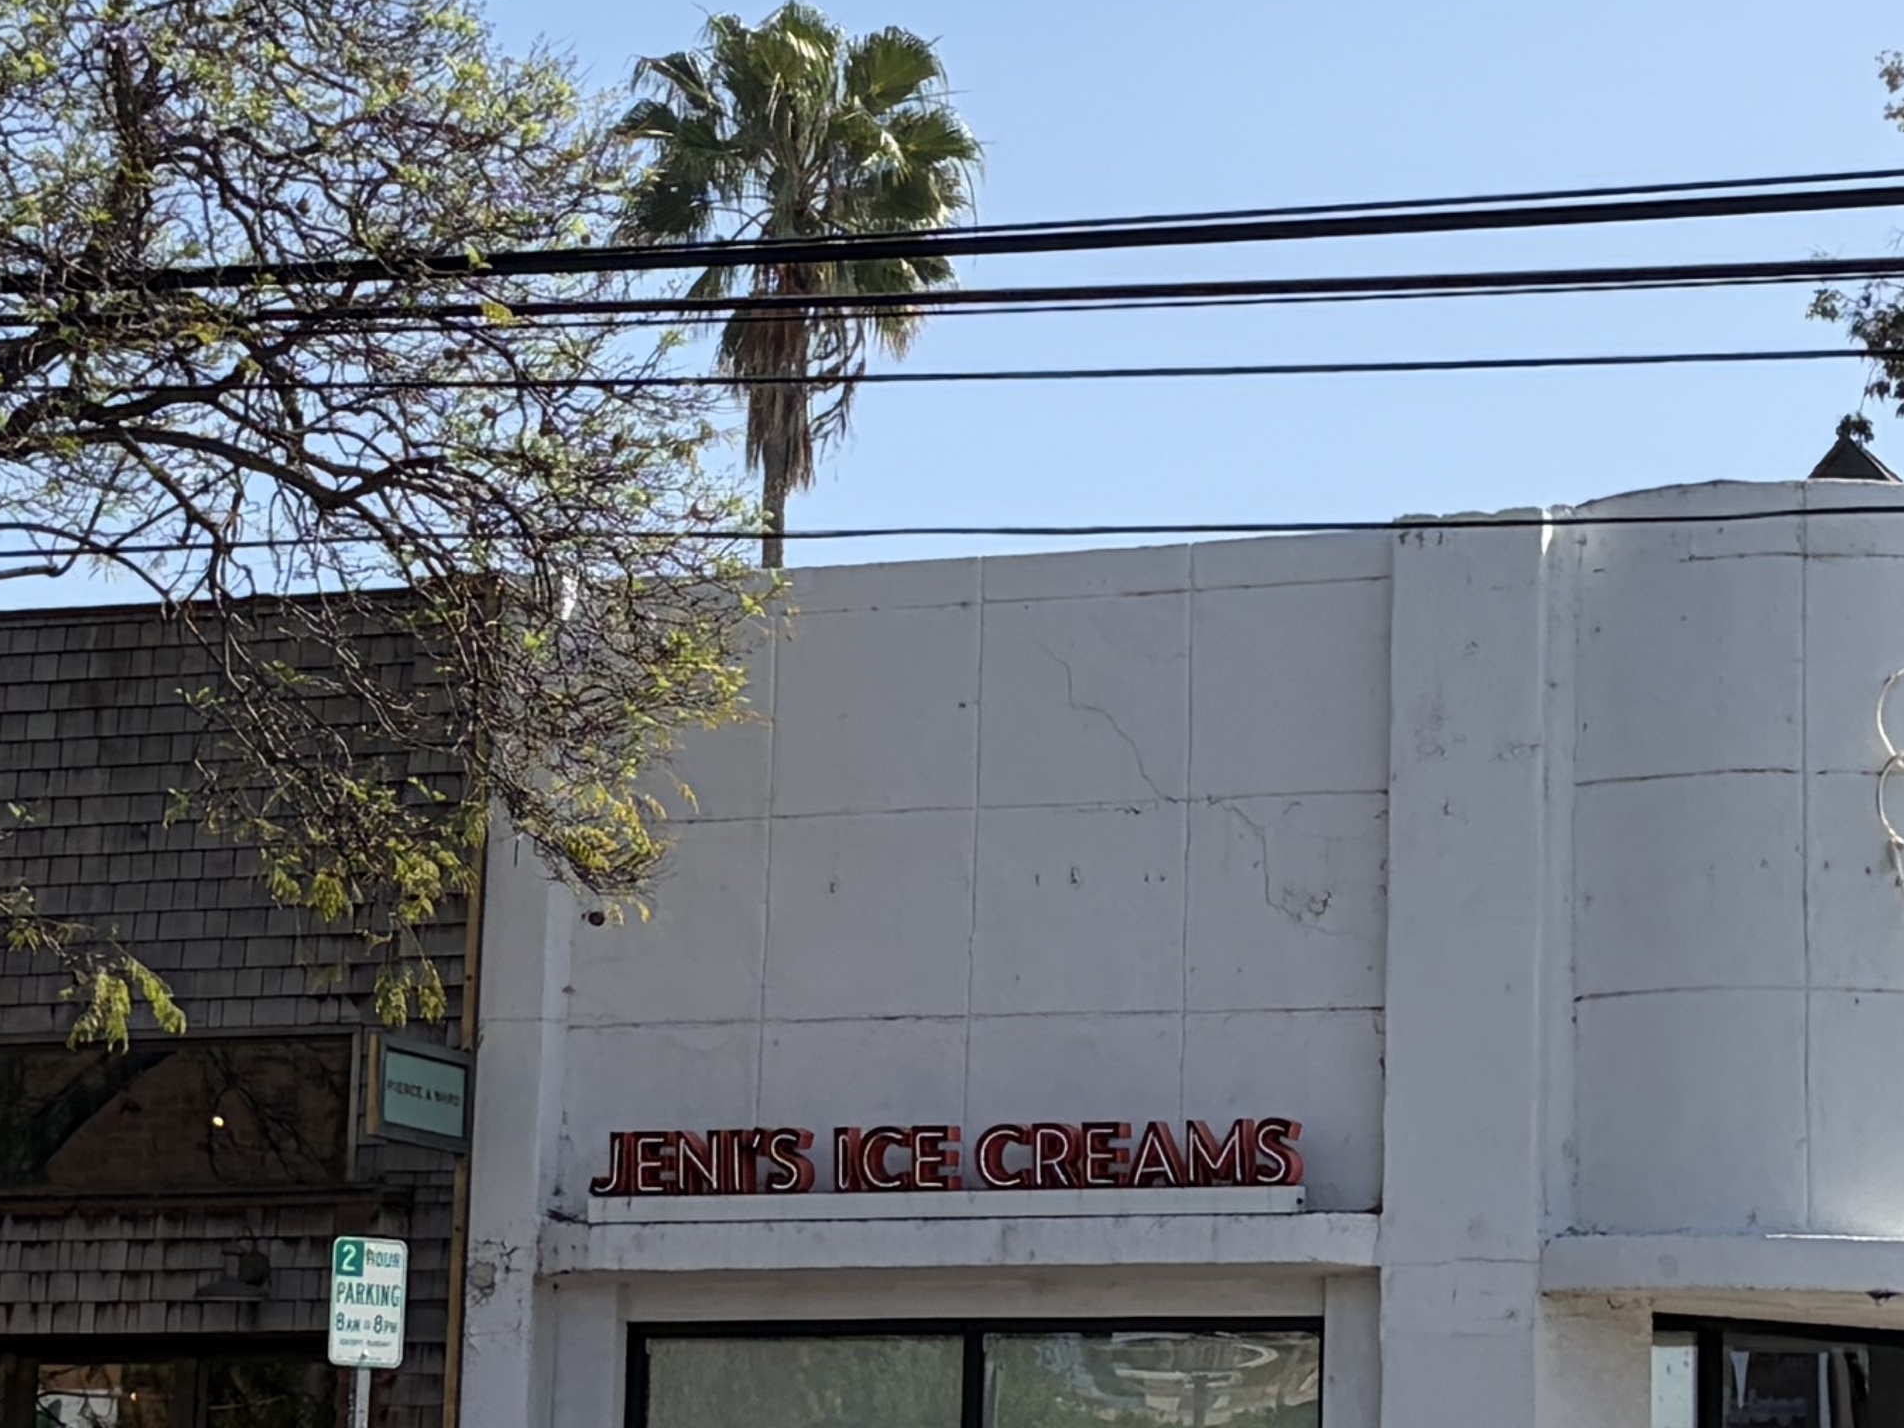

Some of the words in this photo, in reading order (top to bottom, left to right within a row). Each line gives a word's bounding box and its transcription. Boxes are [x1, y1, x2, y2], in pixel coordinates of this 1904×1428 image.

[589, 1126, 814, 1195] JENI'S
[833, 1125, 960, 1192] ICE
[975, 1117, 1303, 1189] CREAMS
[341, 1244, 356, 1271] 2
[336, 1281, 401, 1307] PARKING
